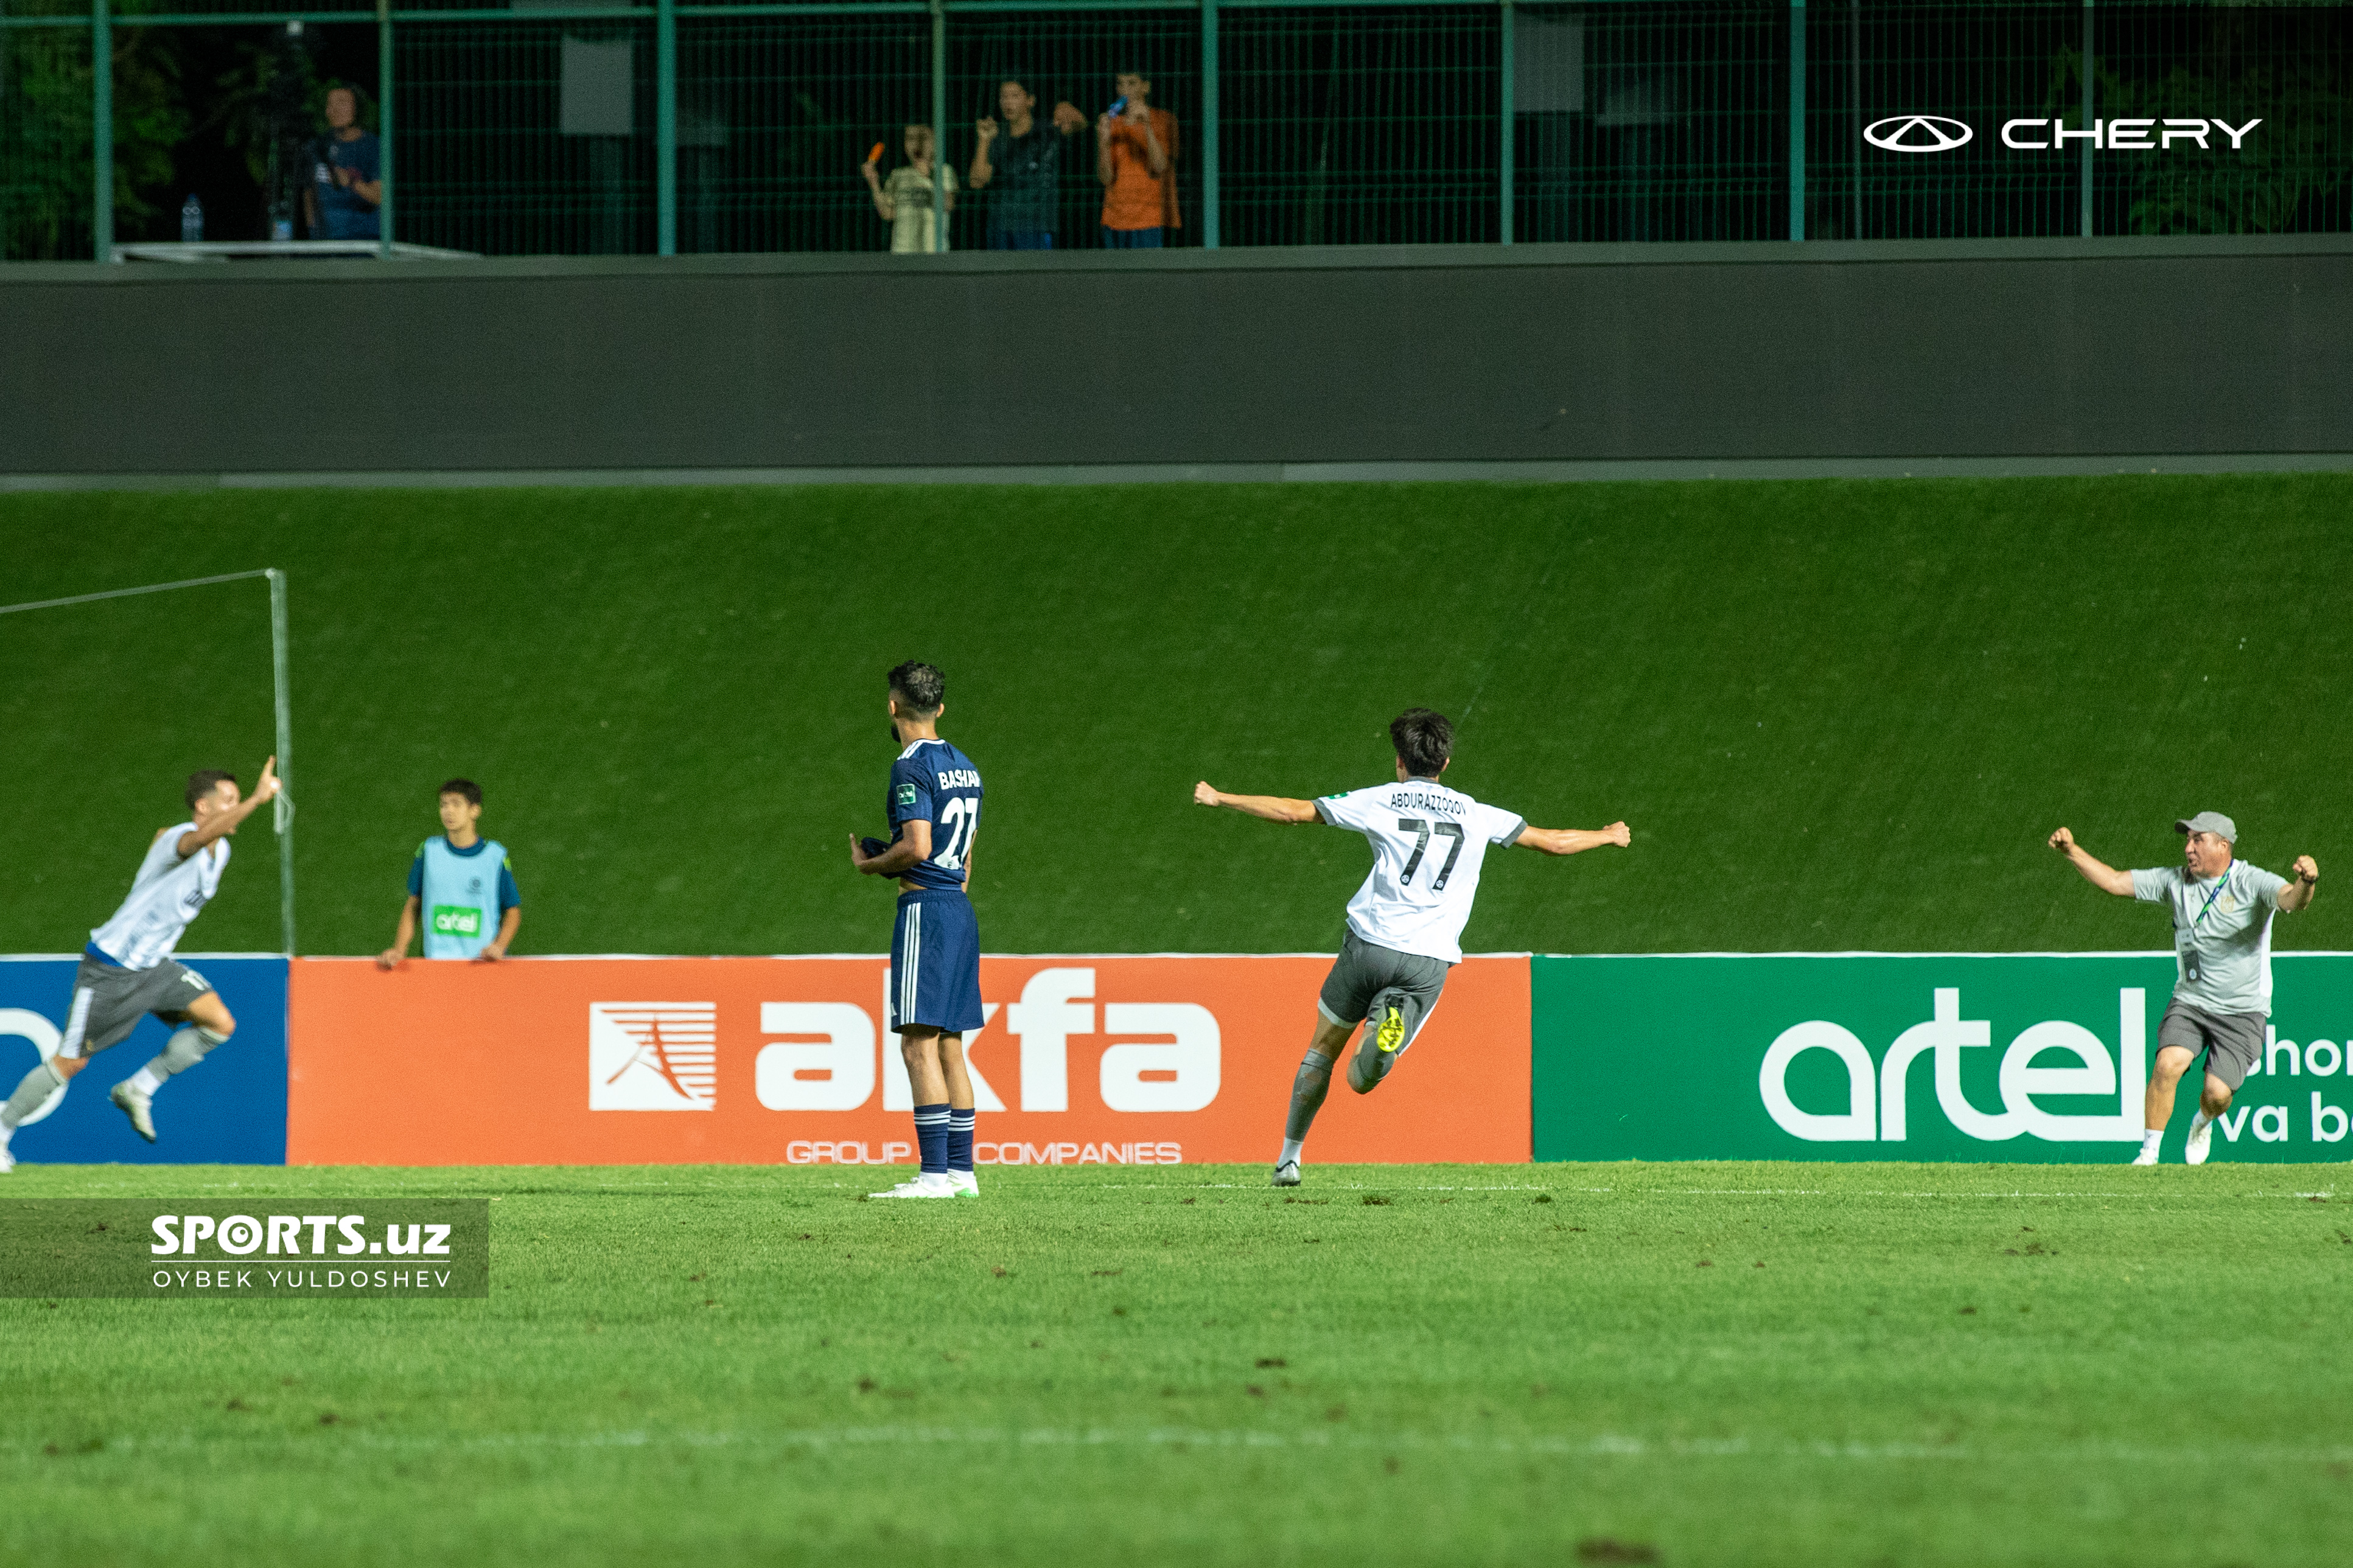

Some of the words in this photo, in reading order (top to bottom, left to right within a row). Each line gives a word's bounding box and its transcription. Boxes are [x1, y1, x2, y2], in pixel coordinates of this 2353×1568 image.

[934, 797, 979, 870] 27
[1399, 818, 1465, 891] 77
[1759, 987, 2146, 1142] artel
[786, 1141, 911, 1165] GROUP
[973, 1141, 1183, 1165] COMPANIES
[2217, 1104, 2288, 1143] va
[2311, 1090, 2353, 1143] b
